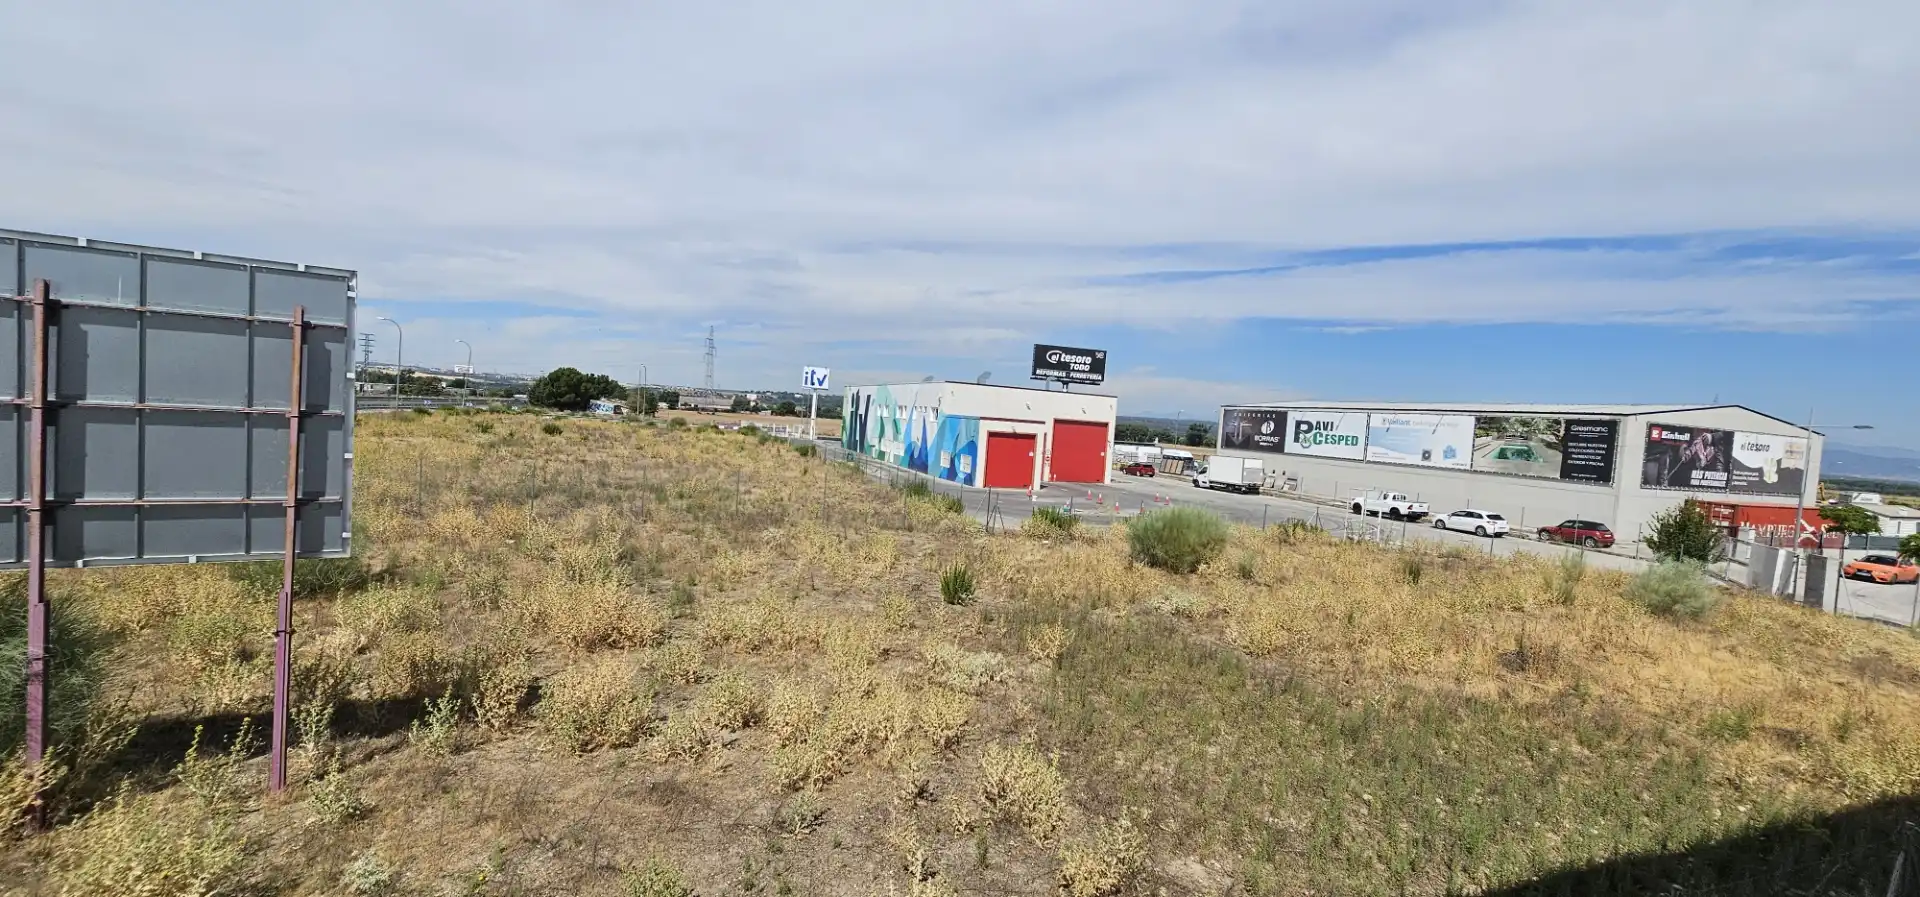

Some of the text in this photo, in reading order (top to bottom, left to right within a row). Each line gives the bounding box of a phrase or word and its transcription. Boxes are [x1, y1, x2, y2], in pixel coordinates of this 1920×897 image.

[1061, 353, 1092, 364] tesoro
[1035, 368, 1066, 377] REFORMAS
[1069, 363, 1091, 371] TODO
[804, 369, 828, 387] itv
[1313, 431, 1359, 447] CESPED
[1746, 441, 1770, 452] tesoro
